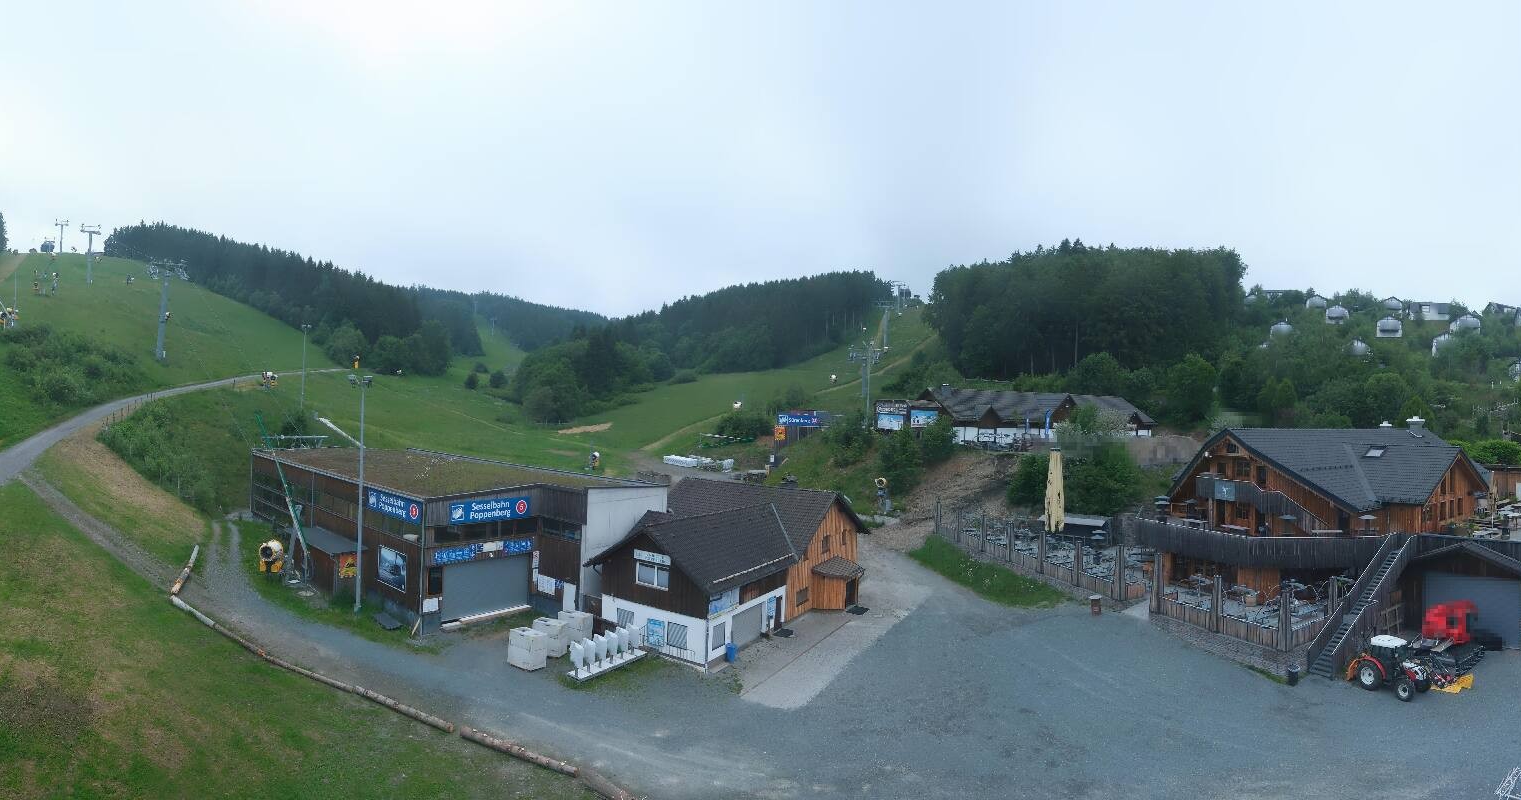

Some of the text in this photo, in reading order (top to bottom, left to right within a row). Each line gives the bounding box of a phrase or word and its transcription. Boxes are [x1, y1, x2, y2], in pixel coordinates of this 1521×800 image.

[380, 493, 406, 508] Sesselbahn
[471, 500, 510, 511] Sesselbahn
[378, 501, 407, 518] Poppenberg
[469, 509, 511, 520] Poppenberg
